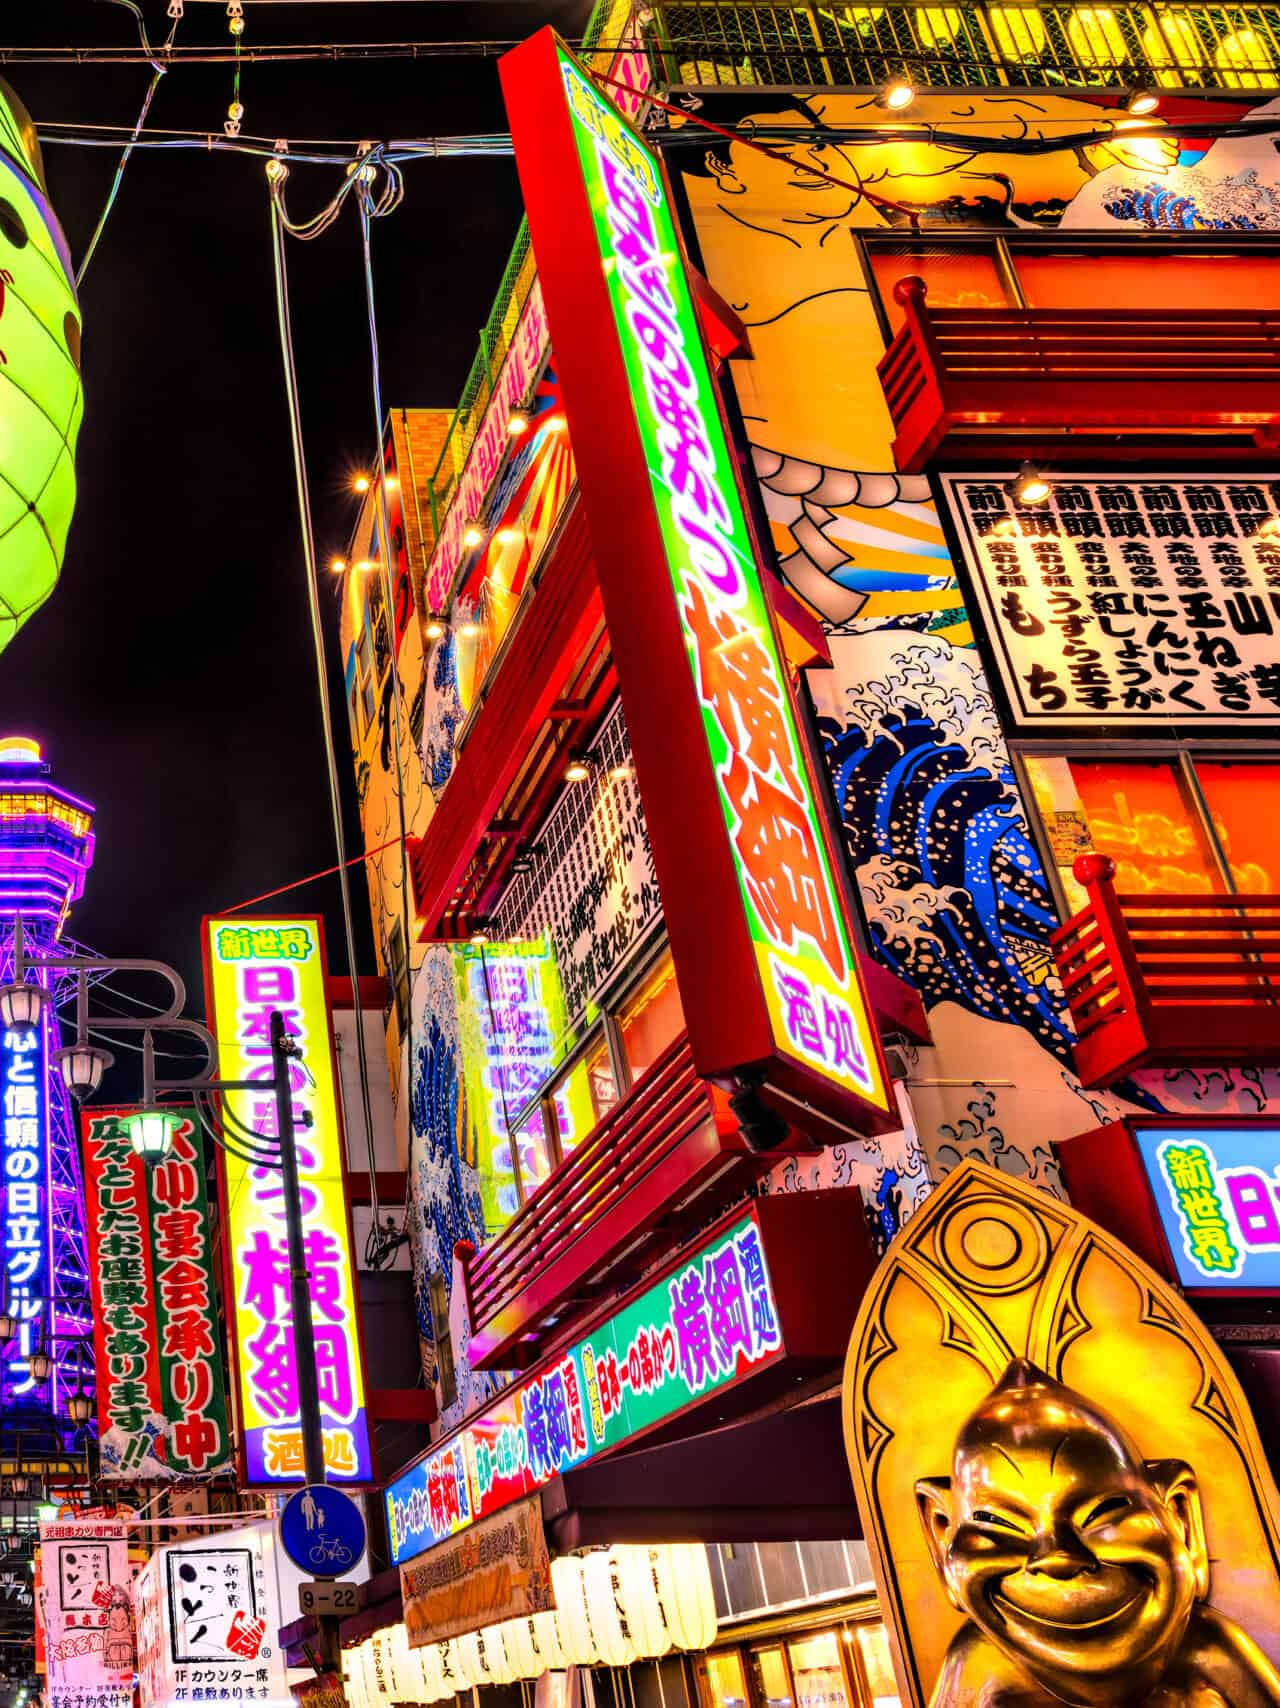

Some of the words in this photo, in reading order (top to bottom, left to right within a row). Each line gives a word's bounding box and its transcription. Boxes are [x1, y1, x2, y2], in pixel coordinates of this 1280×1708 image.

[1001, 591, 1066, 710] もち
[1047, 591, 1118, 709] うずら玉子
[1087, 591, 1165, 709] 紅しょうが
[1133, 592, 1205, 710] にんにく
[1178, 592, 1251, 710] 玉ねぎ
[218, 929, 312, 960] 新世界
[778, 964, 868, 1085] 酒処
[1163, 1145, 1239, 1272] 新世界
[1224, 1173, 1280, 1245] 日
[243, 1230, 353, 1424] 横綱
[670, 1246, 753, 1390] 横綱
[737, 1229, 777, 1350] 酒処
[597, 1326, 675, 1415] 日本一の串かつ
[267, 1431, 357, 1474] 酒処
[175, 1671, 187, 1682] 1F
[192, 1669, 268, 1682] カウンター席
[175, 1688, 188, 1699] 2F
